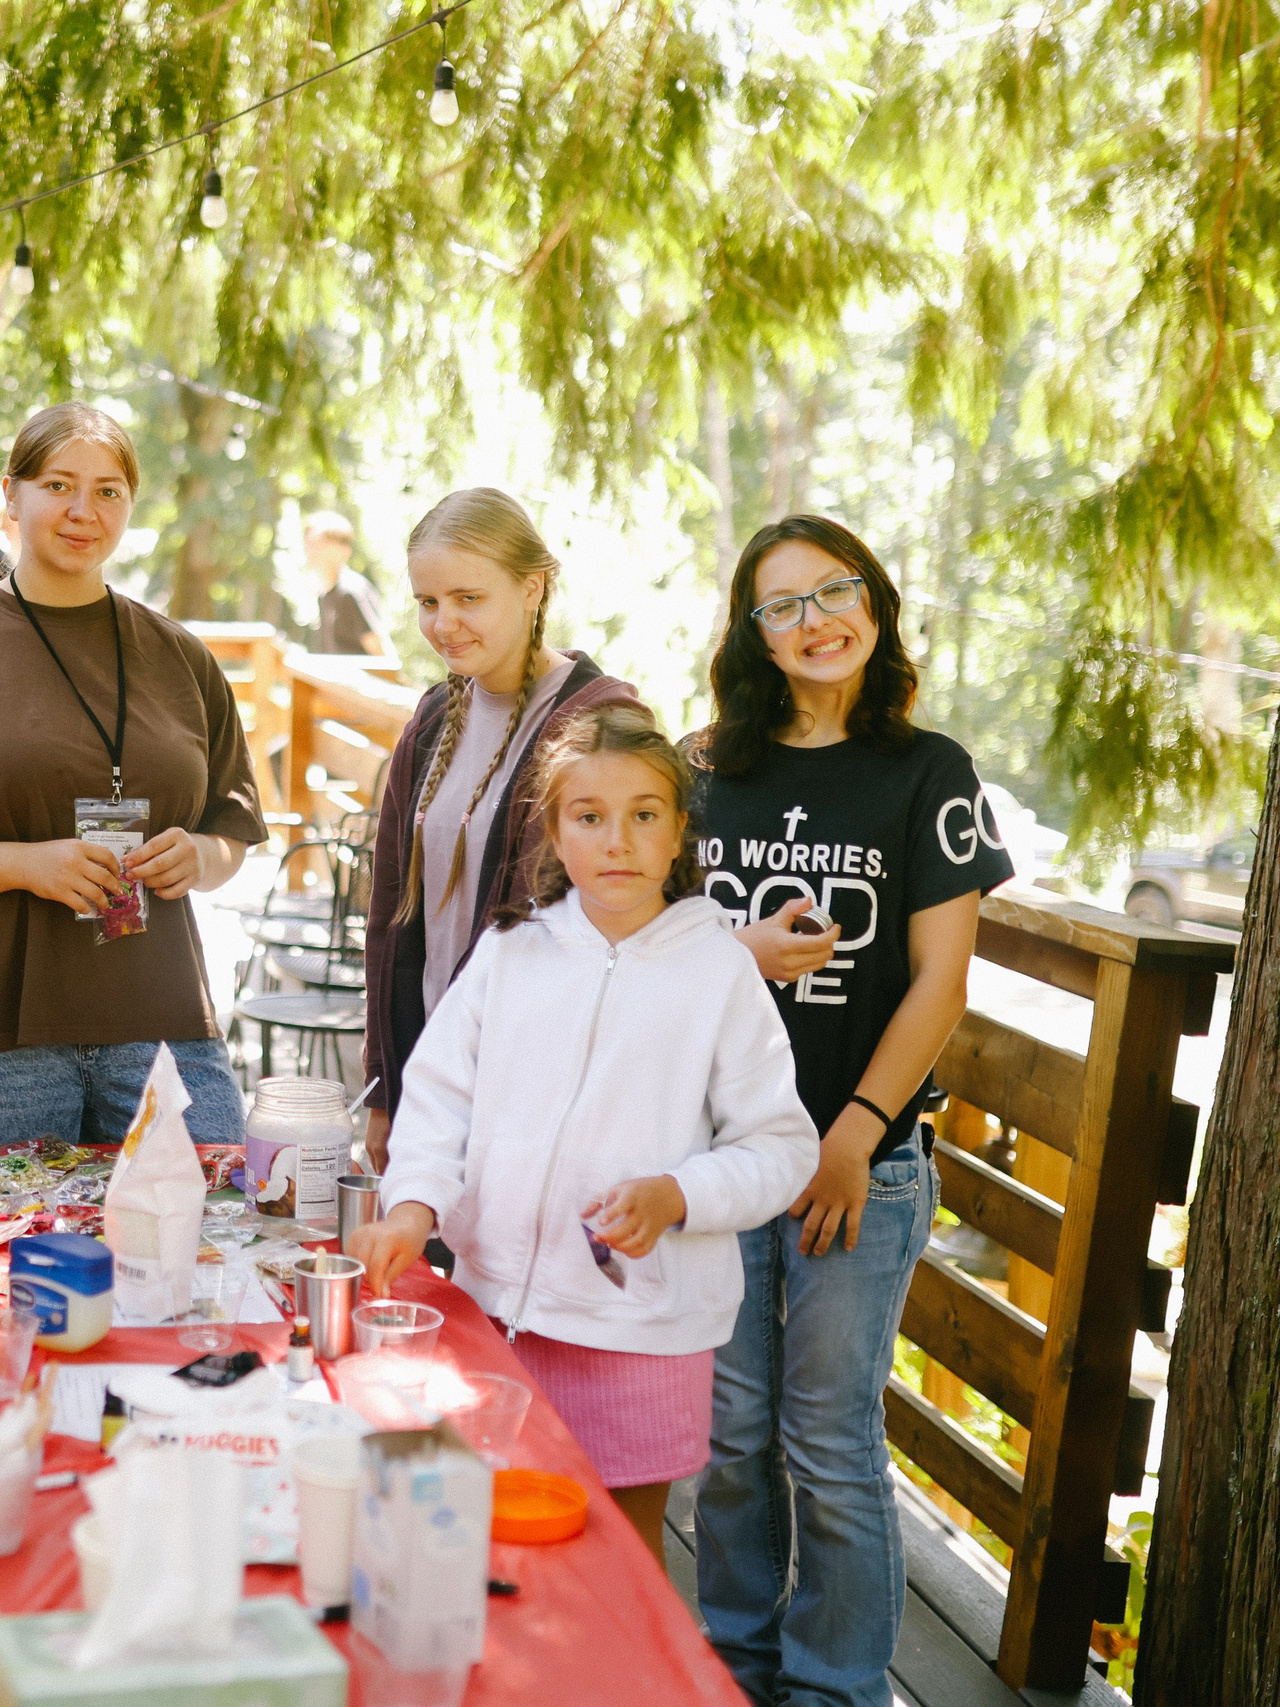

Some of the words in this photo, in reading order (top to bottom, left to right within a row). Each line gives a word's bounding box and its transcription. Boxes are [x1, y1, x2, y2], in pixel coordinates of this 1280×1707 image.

[697, 837, 724, 868] NO
[740, 838, 888, 880] WORRIES.
[704, 871, 878, 952] GOD
